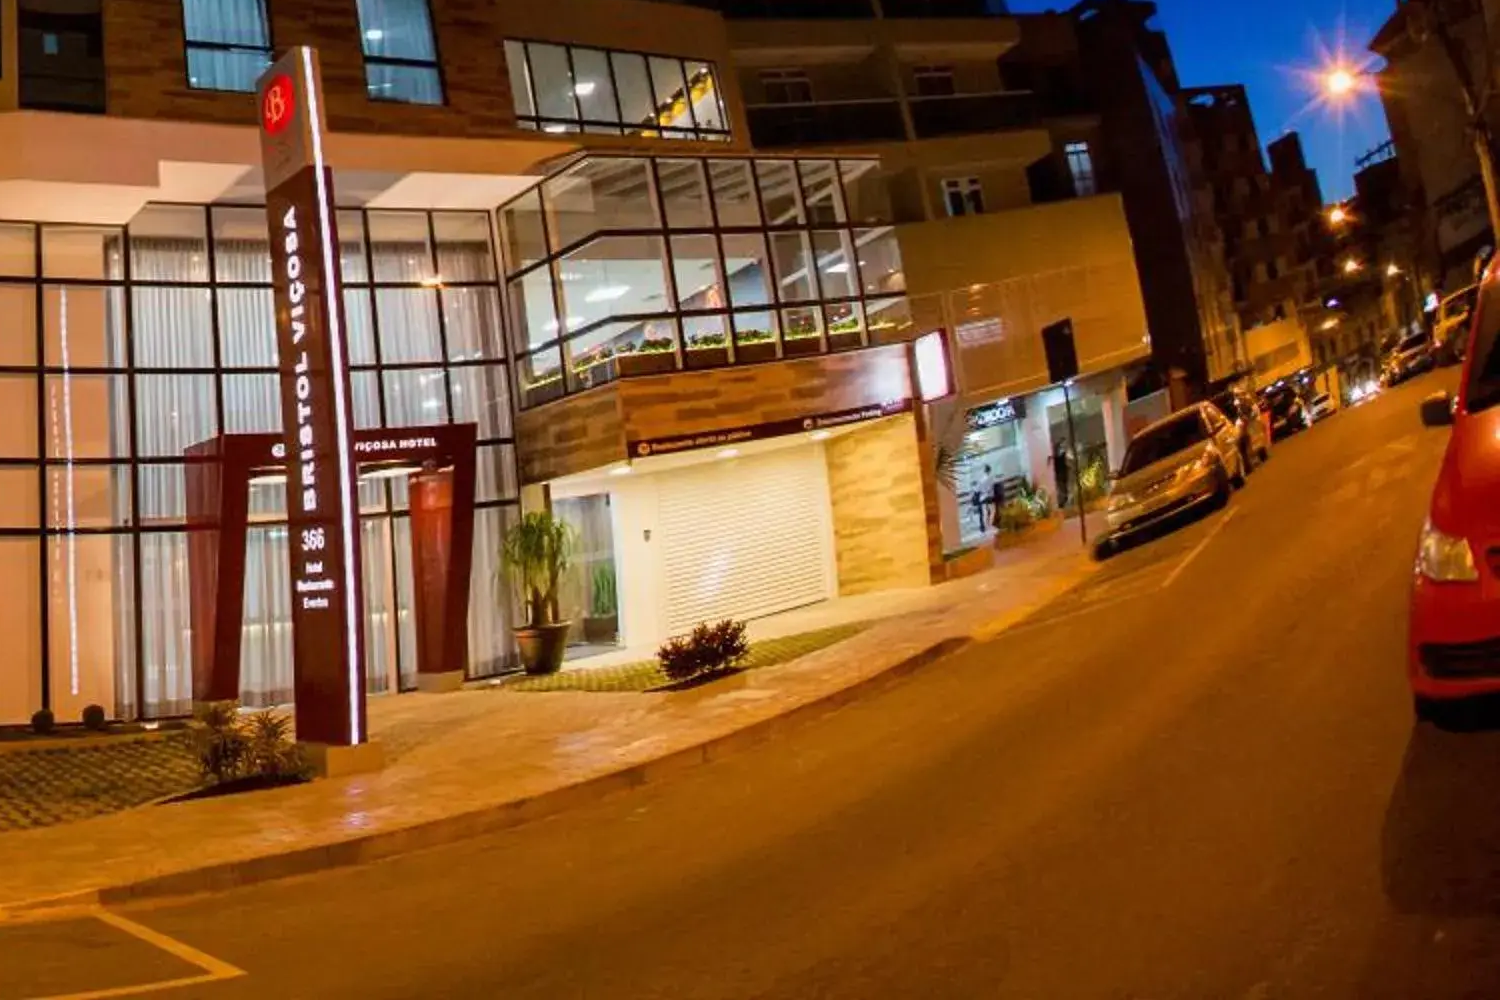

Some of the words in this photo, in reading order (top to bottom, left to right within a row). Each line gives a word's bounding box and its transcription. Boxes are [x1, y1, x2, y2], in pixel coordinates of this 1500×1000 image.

[283, 205, 306, 345] VIÇOSA
[294, 351, 317, 512] BRISTOL
[399, 437, 437, 449] HOTEL
[301, 527, 326, 551] 366
